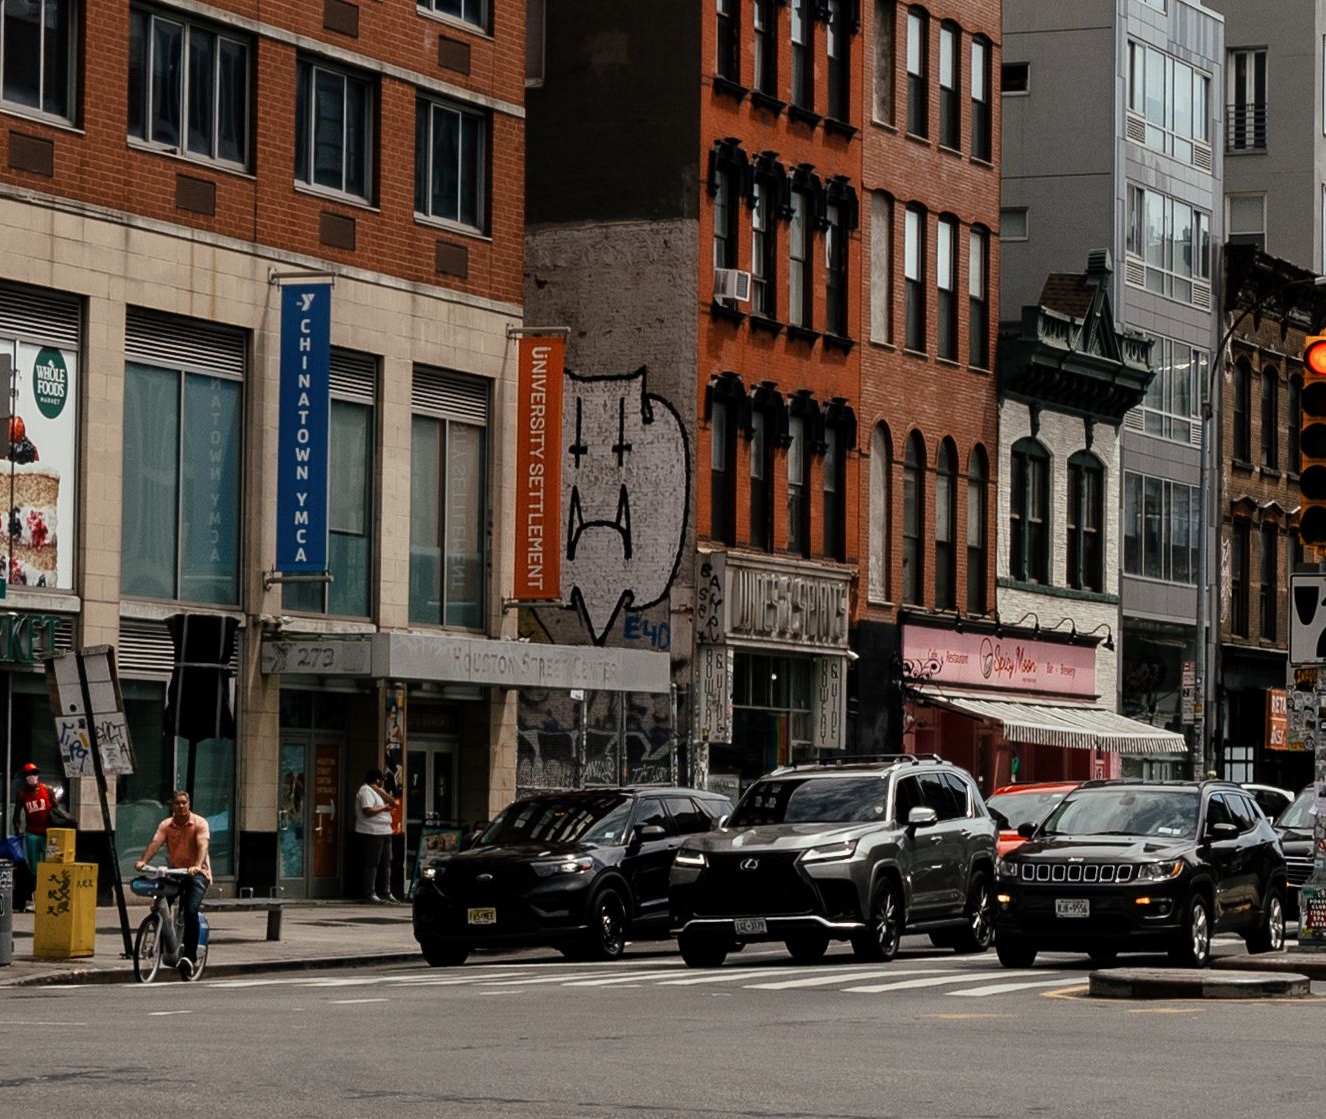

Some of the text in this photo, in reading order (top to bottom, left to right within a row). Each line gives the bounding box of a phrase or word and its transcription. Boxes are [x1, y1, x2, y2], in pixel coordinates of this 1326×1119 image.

[36, 365, 65, 383] WHOLE
[37, 380, 64, 398] FOODS
[294, 318, 312, 562] CHINATOWN YMCA
[527, 463, 545, 591] SETTLEMENT
[297, 647, 335, 668] 273
[453, 646, 617, 681] HOUSTON STREET CENTER
[993, 644, 1014, 679] Spicy
[1014, 646, 1037, 674] Moon
